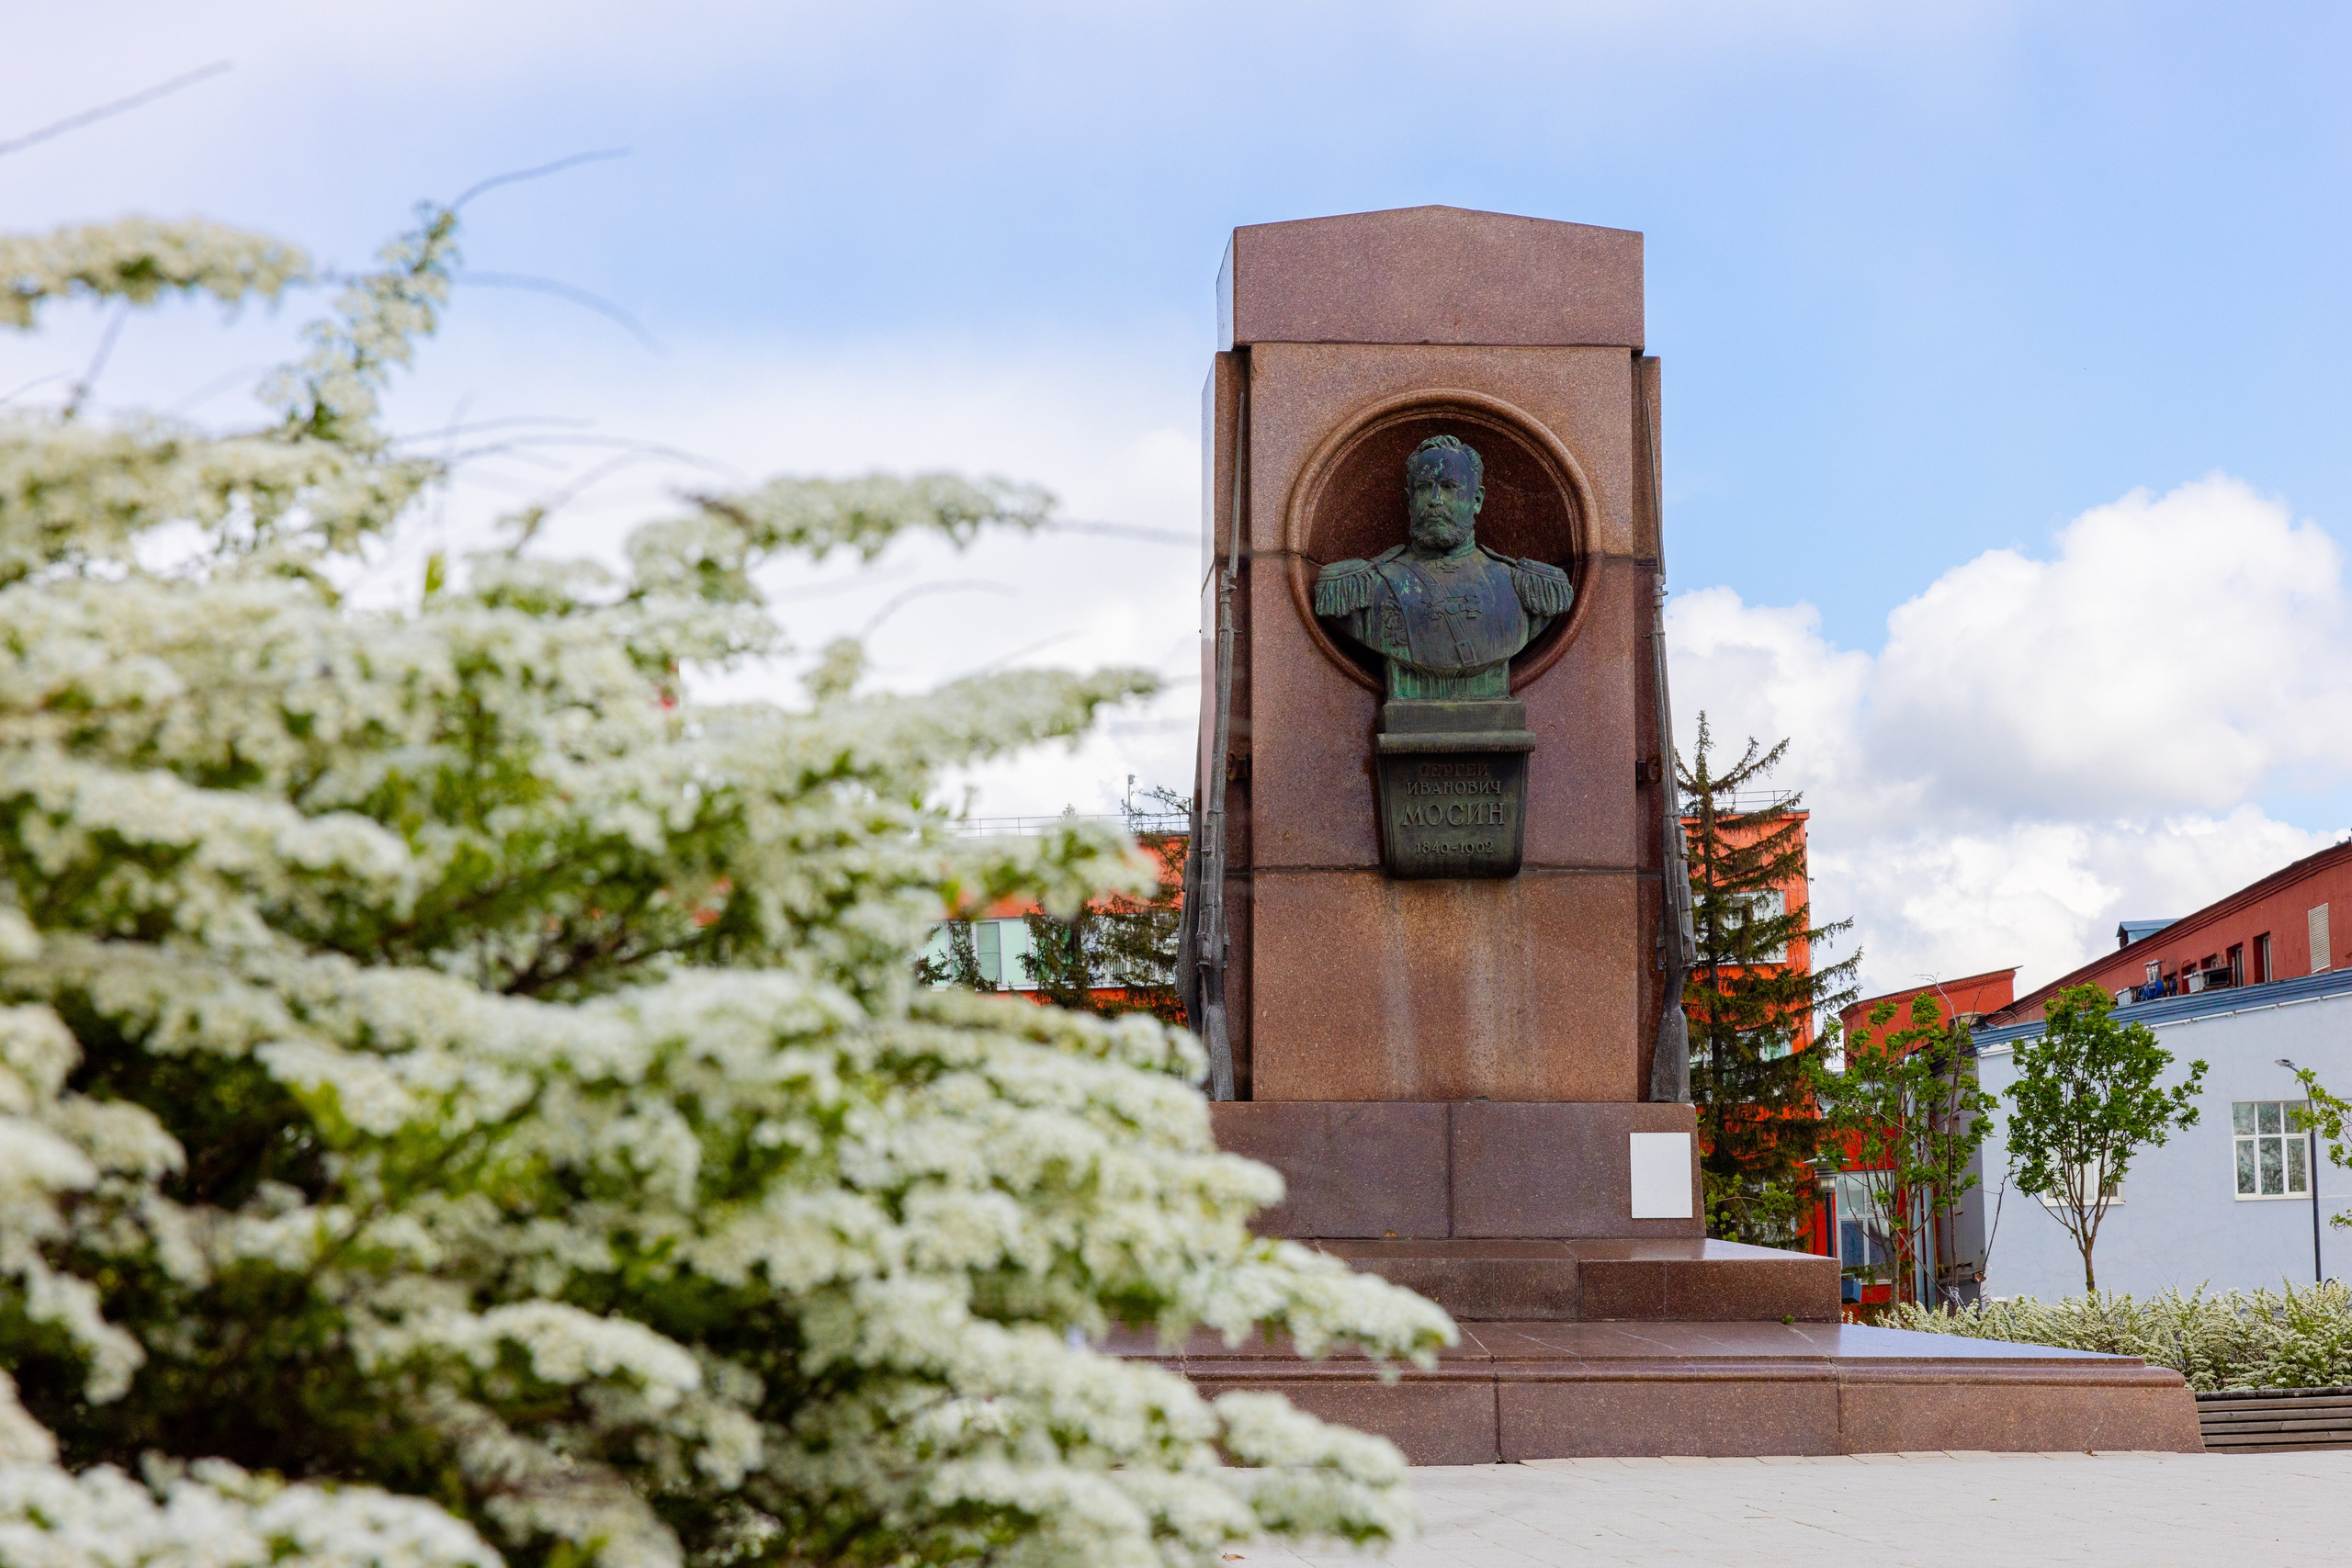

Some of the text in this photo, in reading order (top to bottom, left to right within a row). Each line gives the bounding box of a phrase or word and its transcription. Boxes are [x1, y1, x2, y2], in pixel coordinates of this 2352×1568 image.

[1407, 781, 1501, 795] ИВАНОВИЧ
[1400, 802, 1506, 826] МОСИН
[1416, 840, 1494, 856] 1849-1902
